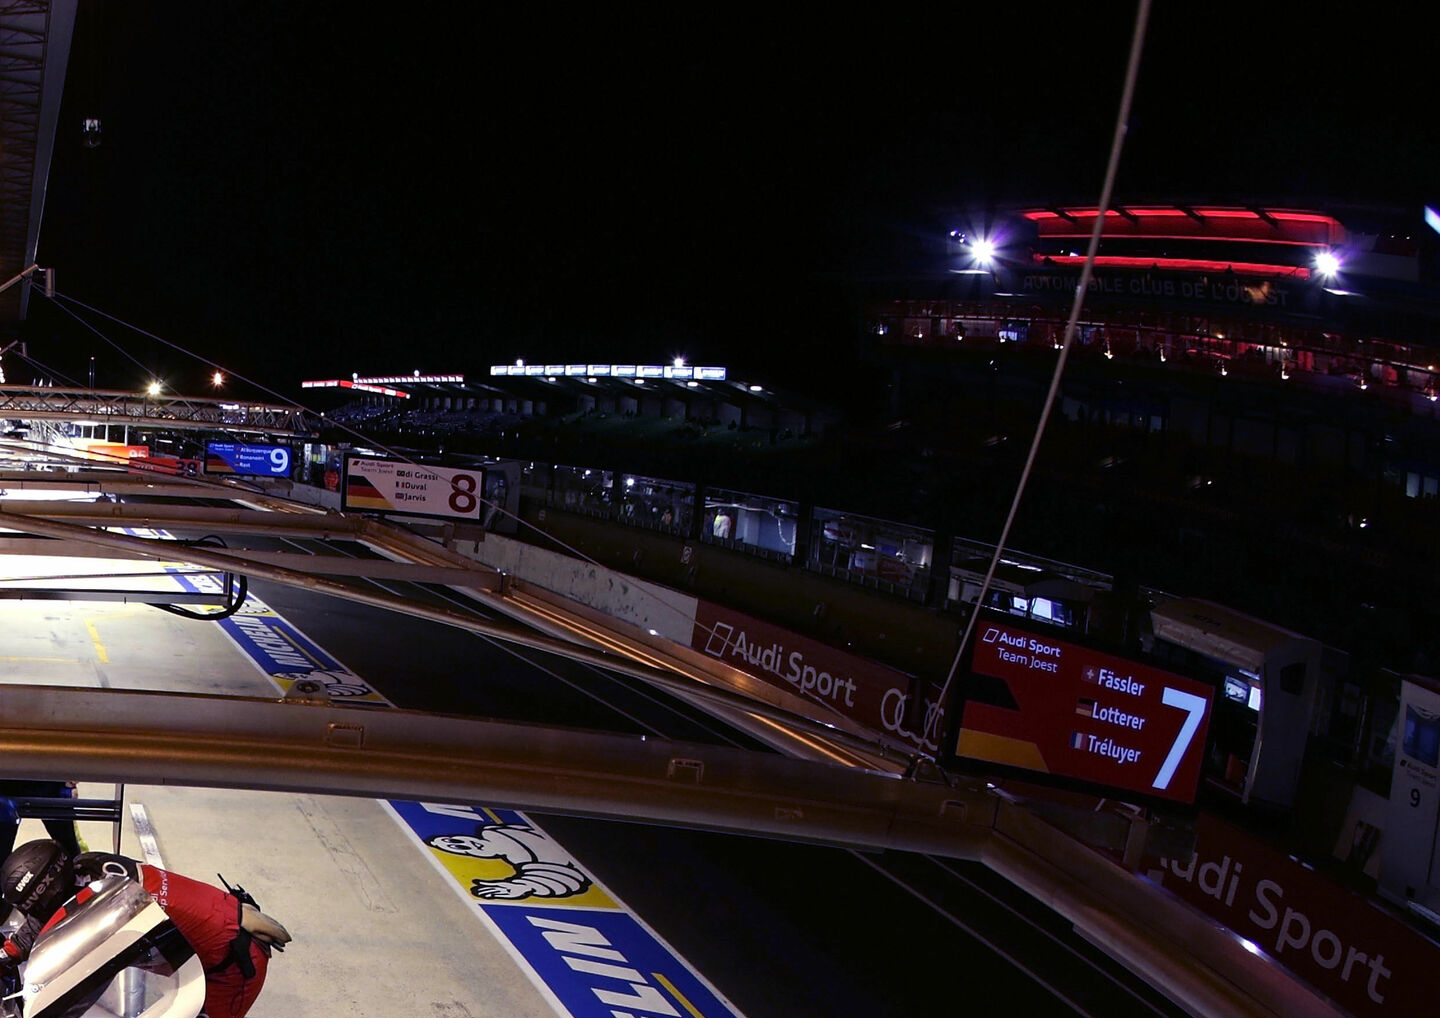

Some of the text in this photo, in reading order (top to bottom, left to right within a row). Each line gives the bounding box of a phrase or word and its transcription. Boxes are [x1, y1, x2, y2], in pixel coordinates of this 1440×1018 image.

[1130, 277, 1176, 297] CLUB
[1182, 281, 1206, 299] DE
[270, 448, 289, 473] 9
[404, 493, 426, 502] Jarvis
[405, 482, 427, 491] Duval
[448, 474, 477, 514] 8
[231, 615, 315, 668] MICHELIN
[999, 631, 1061, 657] Audi Sport
[732, 631, 857, 708] Audi Sport
[998, 647, 1058, 673] Team Joest
[1097, 668, 1145, 697] Fässler
[1092, 702, 1146, 731] Lotterer
[1088, 734, 1141, 764] Tréluyer
[1152, 687, 1207, 790] 7
[16, 871, 34, 893] uvex
[22, 874, 56, 910] uvex
[1248, 879, 1393, 1005] Sport
